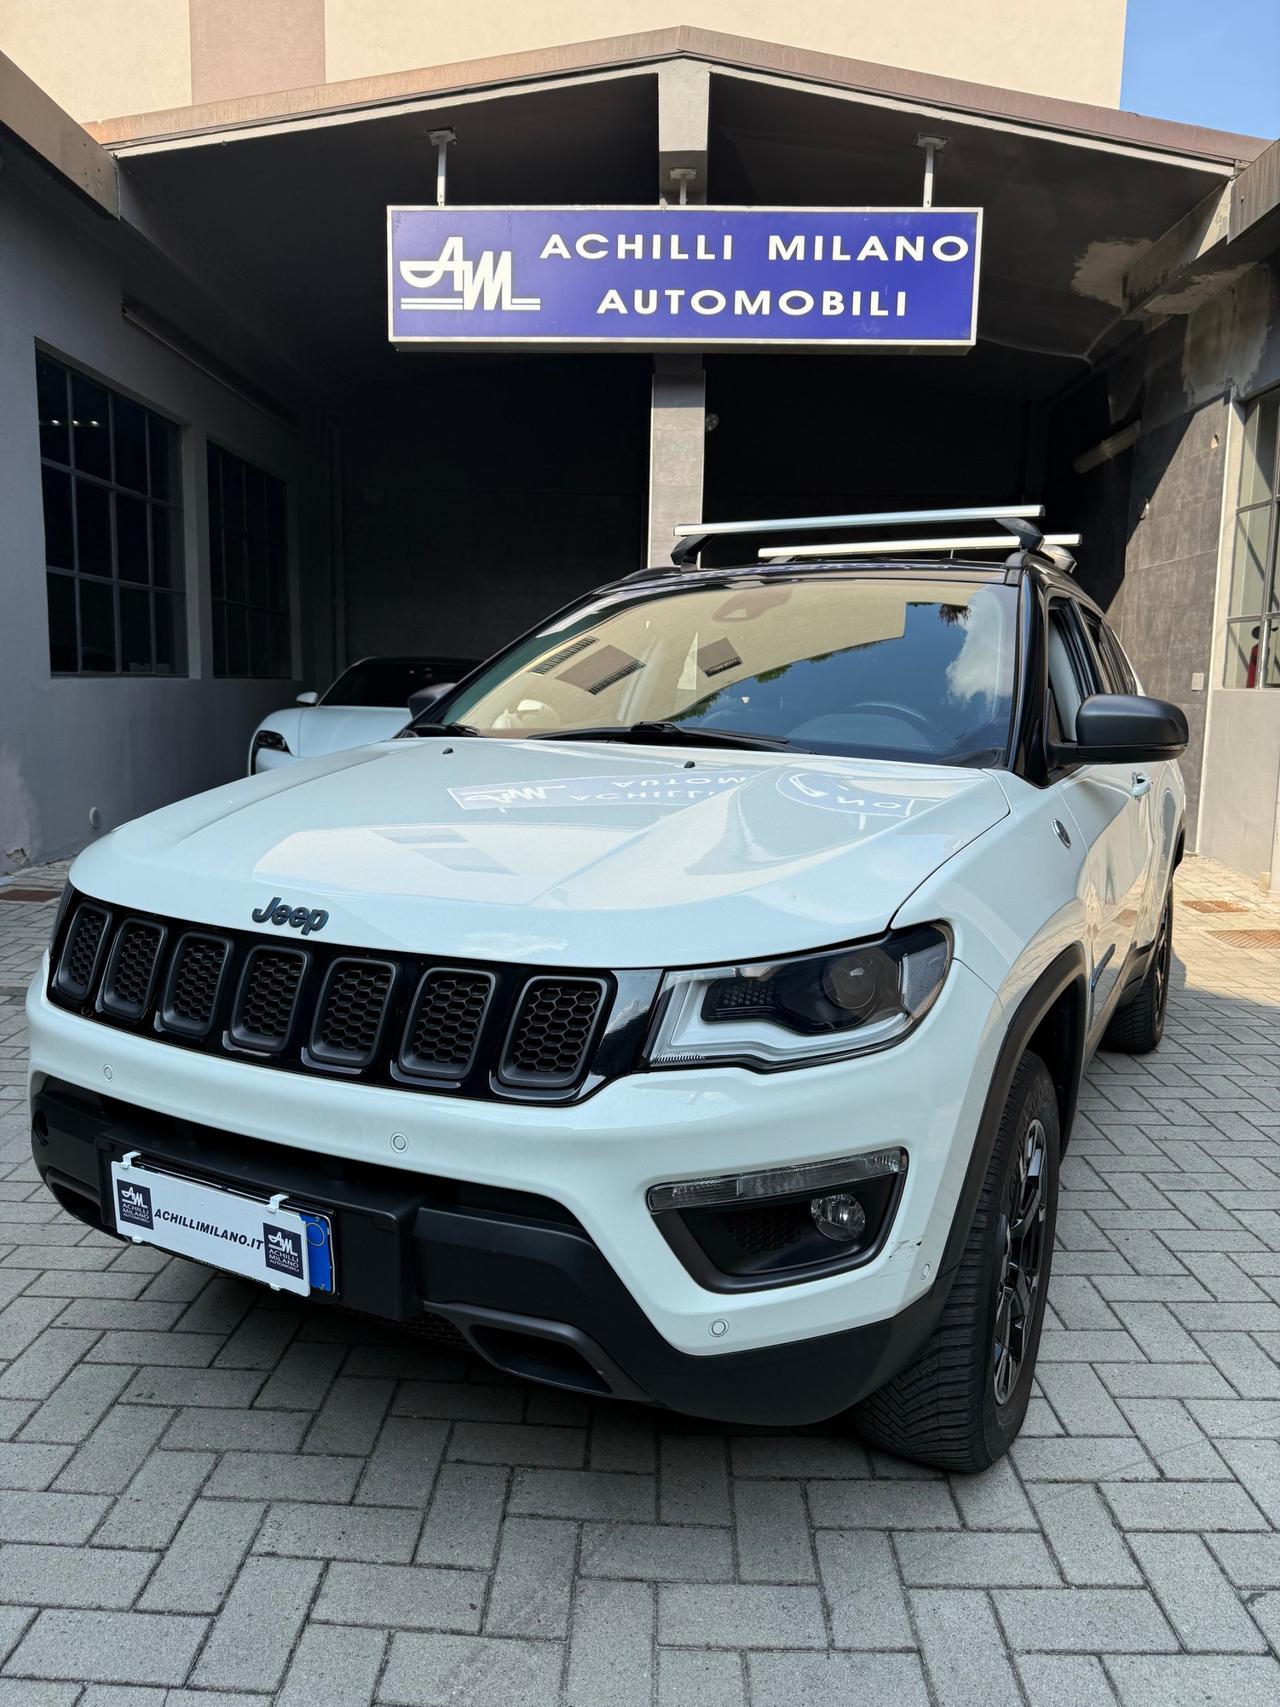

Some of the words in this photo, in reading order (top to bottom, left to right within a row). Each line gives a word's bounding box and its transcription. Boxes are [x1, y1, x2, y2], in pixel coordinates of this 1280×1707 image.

[540, 233, 733, 261] ACHILLI
[768, 234, 969, 262] MILANO
[596, 289, 907, 317] AUTOMOBILI
[252, 896, 330, 936] Jeep
[122, 1203, 149, 1215] ACHILLI
[122, 1208, 150, 1220] MILANO
[154, 1208, 264, 1250] ACHILLIMILANO.IT
[268, 1248, 299, 1263] ACHILLI
[268, 1253, 299, 1269] MILANO
